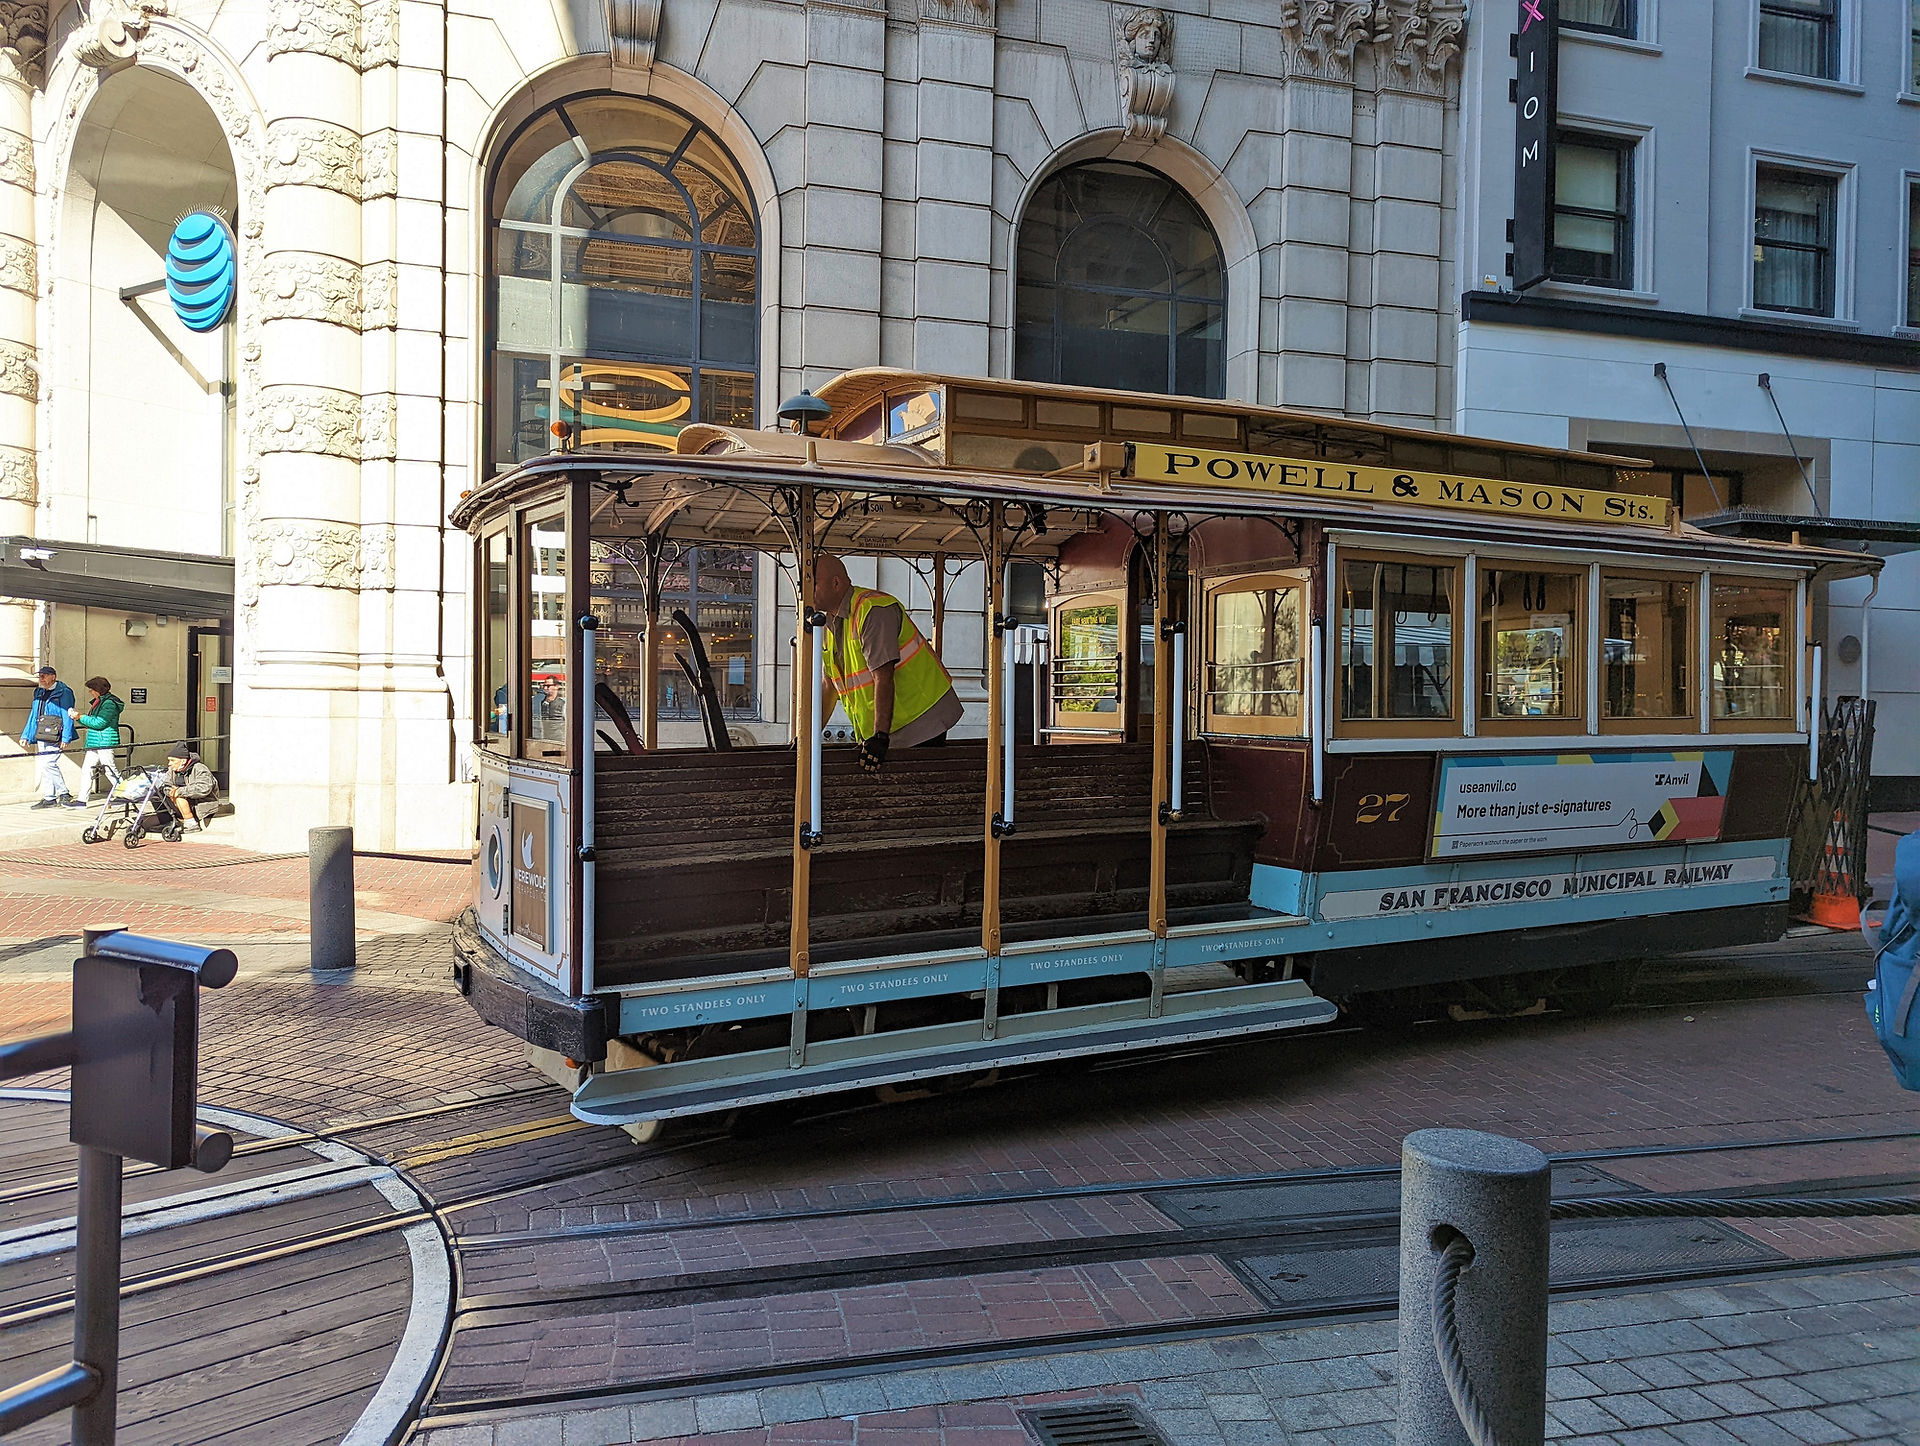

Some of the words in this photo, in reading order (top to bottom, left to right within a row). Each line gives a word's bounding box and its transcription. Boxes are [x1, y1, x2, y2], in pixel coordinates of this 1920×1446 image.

[1164, 453, 1374, 494] POWELL
[1391, 474, 1419, 498] &
[1438, 480, 1584, 513] MASON
[1604, 497, 1654, 520] Sts.
[860, 501, 884, 512] MSON
[1459, 780, 1517, 794] useanvil.co
[1664, 773, 1690, 786] Anvil
[1355, 793, 1410, 824] 27
[1457, 804, 1488, 819] More
[1490, 803, 1515, 817] than
[1516, 801, 1540, 819] just
[1541, 799, 1612, 815] e-signatures
[1460, 840, 1484, 849] Paperwork
[1510, 838, 1523, 846] paper
[1379, 889, 1426, 911] SAN
[1433, 879, 1552, 906] FRANCISCO
[1563, 870, 1656, 895] MUNICIPAL
[1664, 863, 1733, 885] RAILWAY
[1201, 943, 1219, 953] TWO
[1222, 940, 1262, 951] STANDEES
[1265, 937, 1285, 946] ONLY
[1030, 962, 1051, 971] TWO
[1054, 956, 1098, 968] STANDEES
[1101, 954, 1124, 963] ONLY
[841, 984, 866, 994] TWO
[869, 977, 919, 990] STANDEES
[923, 973, 949, 984] ONLY
[641, 1006, 669, 1017] TWO
[673, 998, 735, 1013] STANDEES
[736, 994, 766, 1005] ONLY
